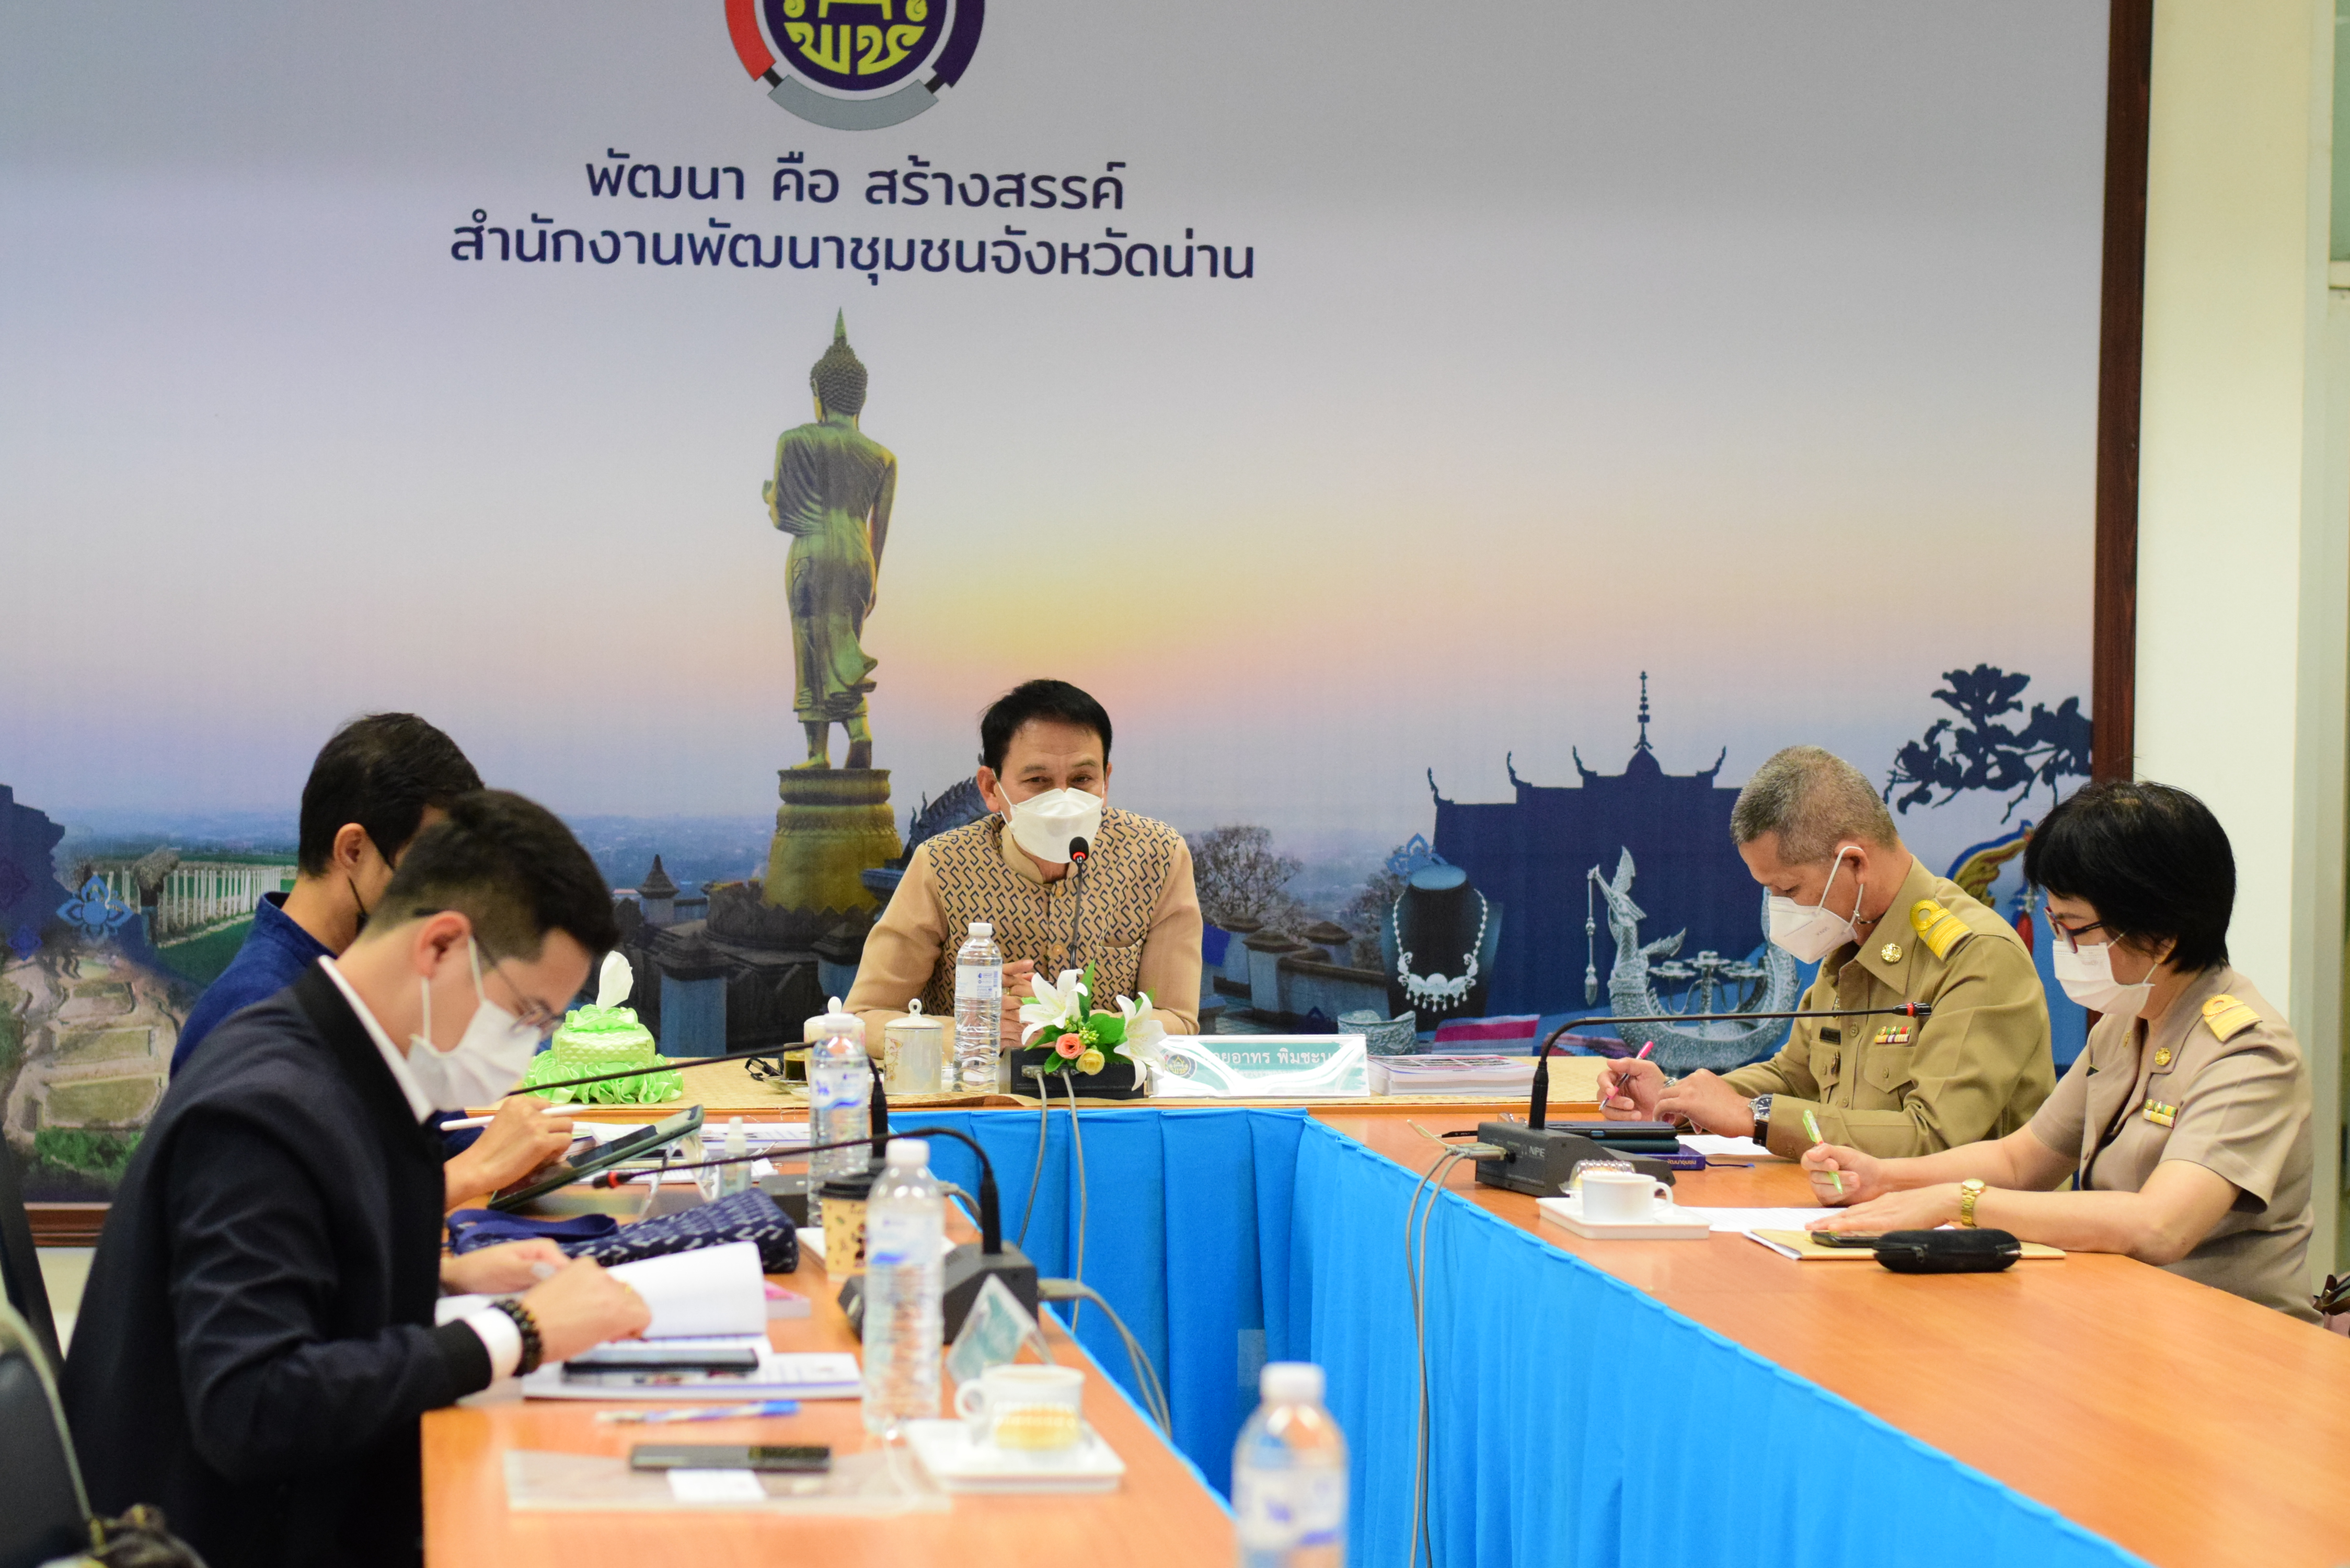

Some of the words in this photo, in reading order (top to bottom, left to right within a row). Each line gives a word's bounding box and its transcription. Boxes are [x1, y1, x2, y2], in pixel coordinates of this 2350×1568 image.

[585, 147, 745, 202] พัฒนา
[773, 151, 840, 204] คือ
[865, 155, 1127, 212] สร้างสรรค์
[451, 208, 1254, 286] สำนักงานพัฒนาชุมชนจังหวัดน่าน
